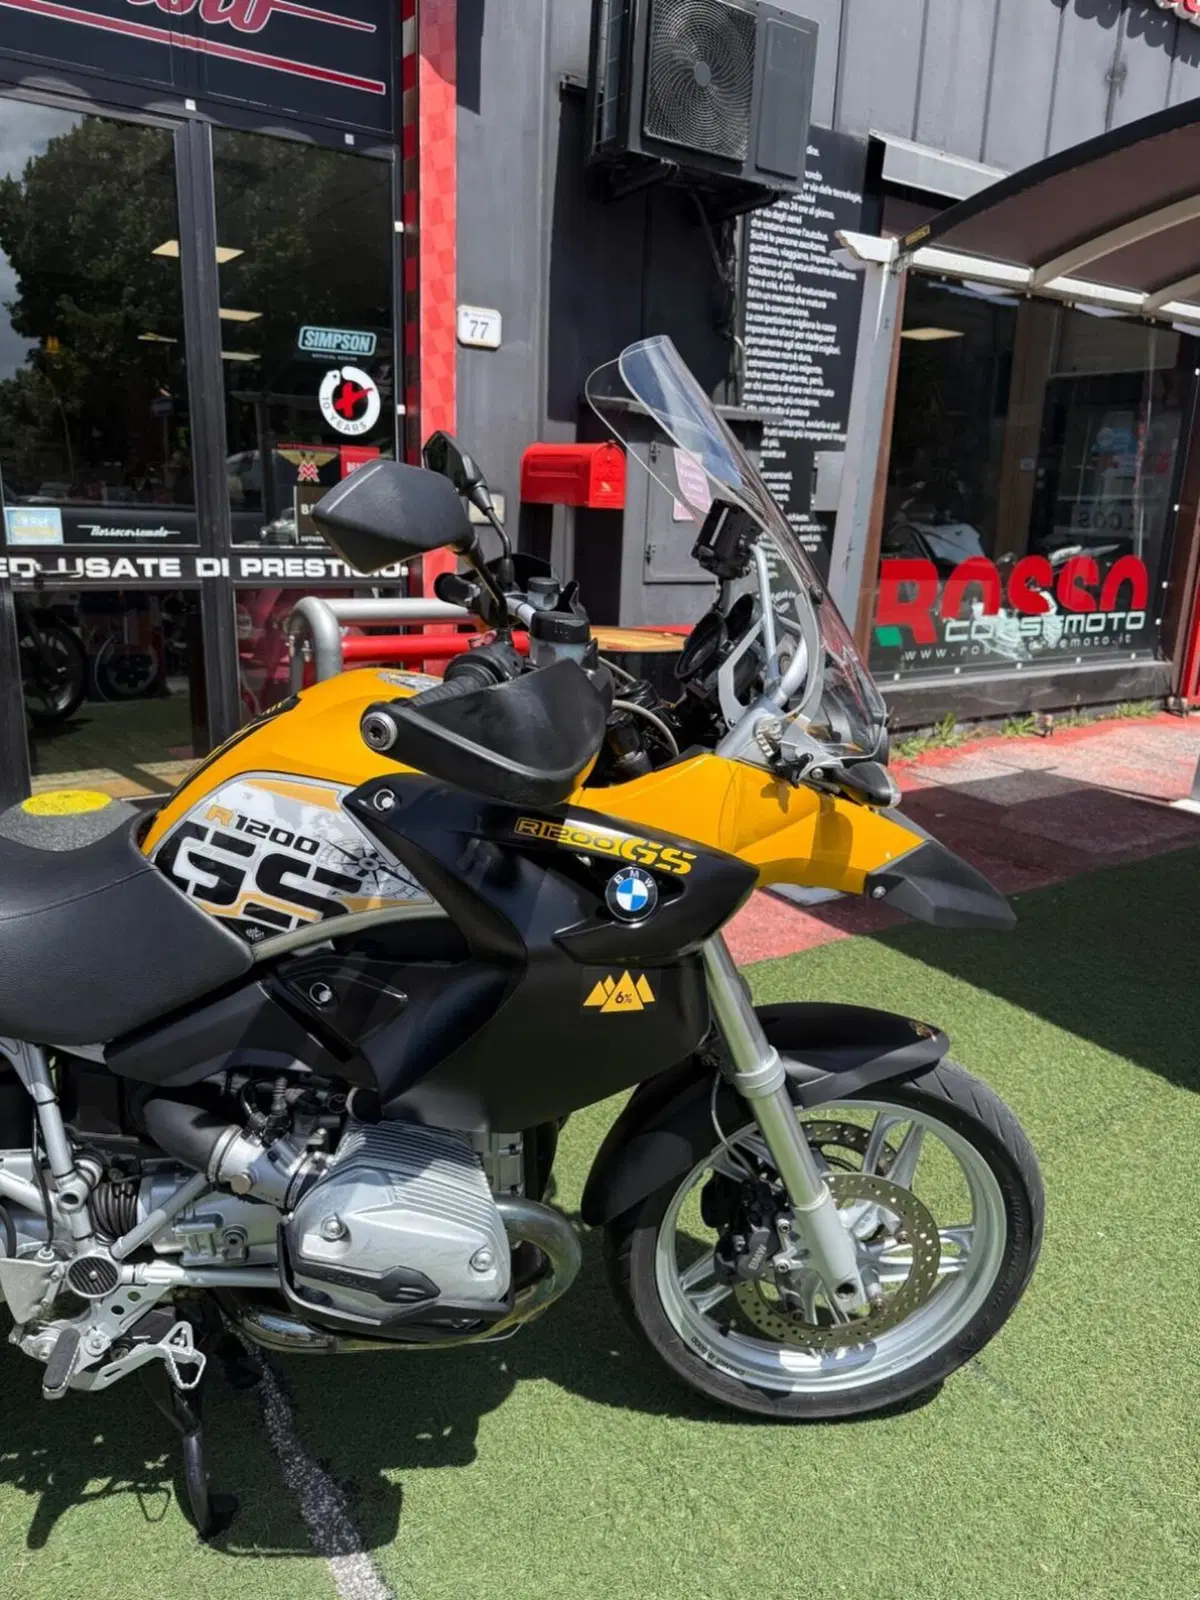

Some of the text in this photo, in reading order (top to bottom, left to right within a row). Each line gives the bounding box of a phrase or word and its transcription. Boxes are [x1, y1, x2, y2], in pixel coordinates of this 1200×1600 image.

[470, 320, 489, 339] 77
[304, 330, 372, 352] SIMPSON
[329, 414, 368, 433] YEARS
[56, 557, 182, 579] USATE
[196, 557, 229, 578] DI
[241, 557, 409, 579] PRESTIO.
[205, 804, 321, 855] R1200
[154, 820, 362, 930] GS
[613, 869, 656, 889] BMW
